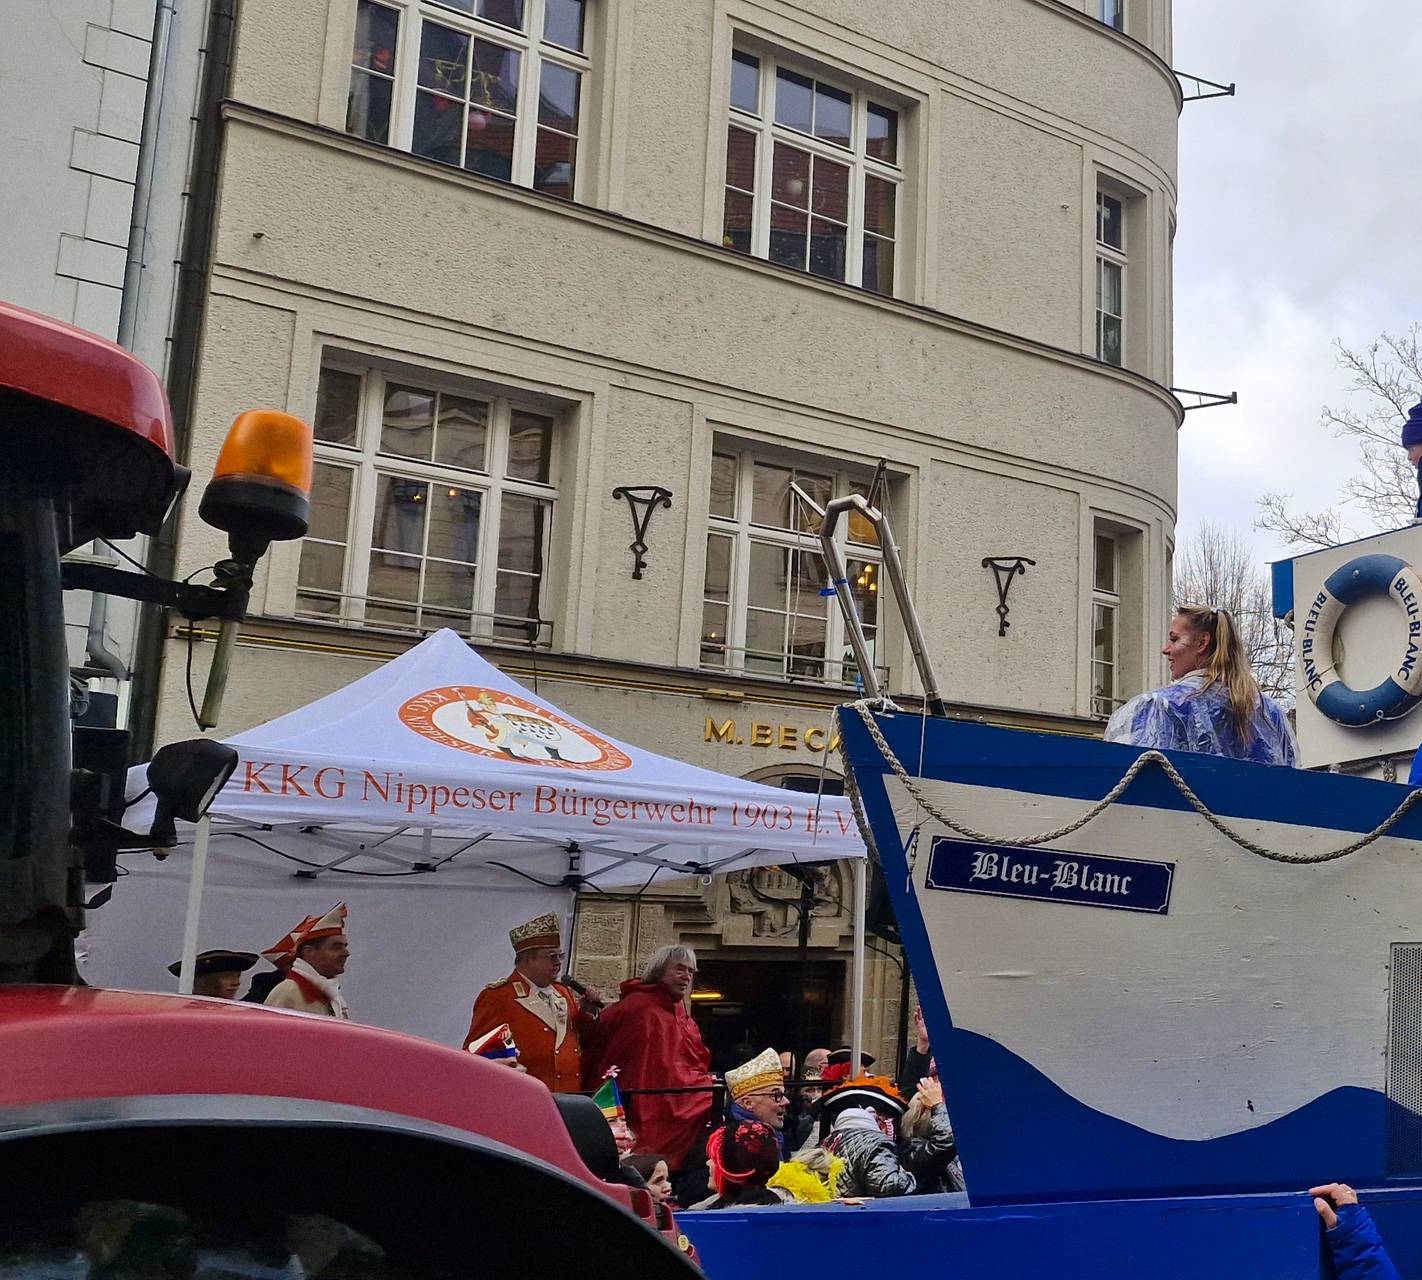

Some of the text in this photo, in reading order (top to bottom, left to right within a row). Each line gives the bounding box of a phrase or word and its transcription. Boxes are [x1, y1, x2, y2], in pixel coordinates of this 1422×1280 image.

[1302, 591, 1328, 692] BLEU-BLANC
[1393, 577, 1421, 682] BLEU-BLANC
[406, 691, 451, 713] KKG
[241, 761, 347, 800] KKG
[360, 769, 522, 815] Nippeser
[534, 784, 721, 826] Bürgerwehr
[730, 801, 794, 831] 1903
[969, 851, 1132, 895] Bleu-Blanc
